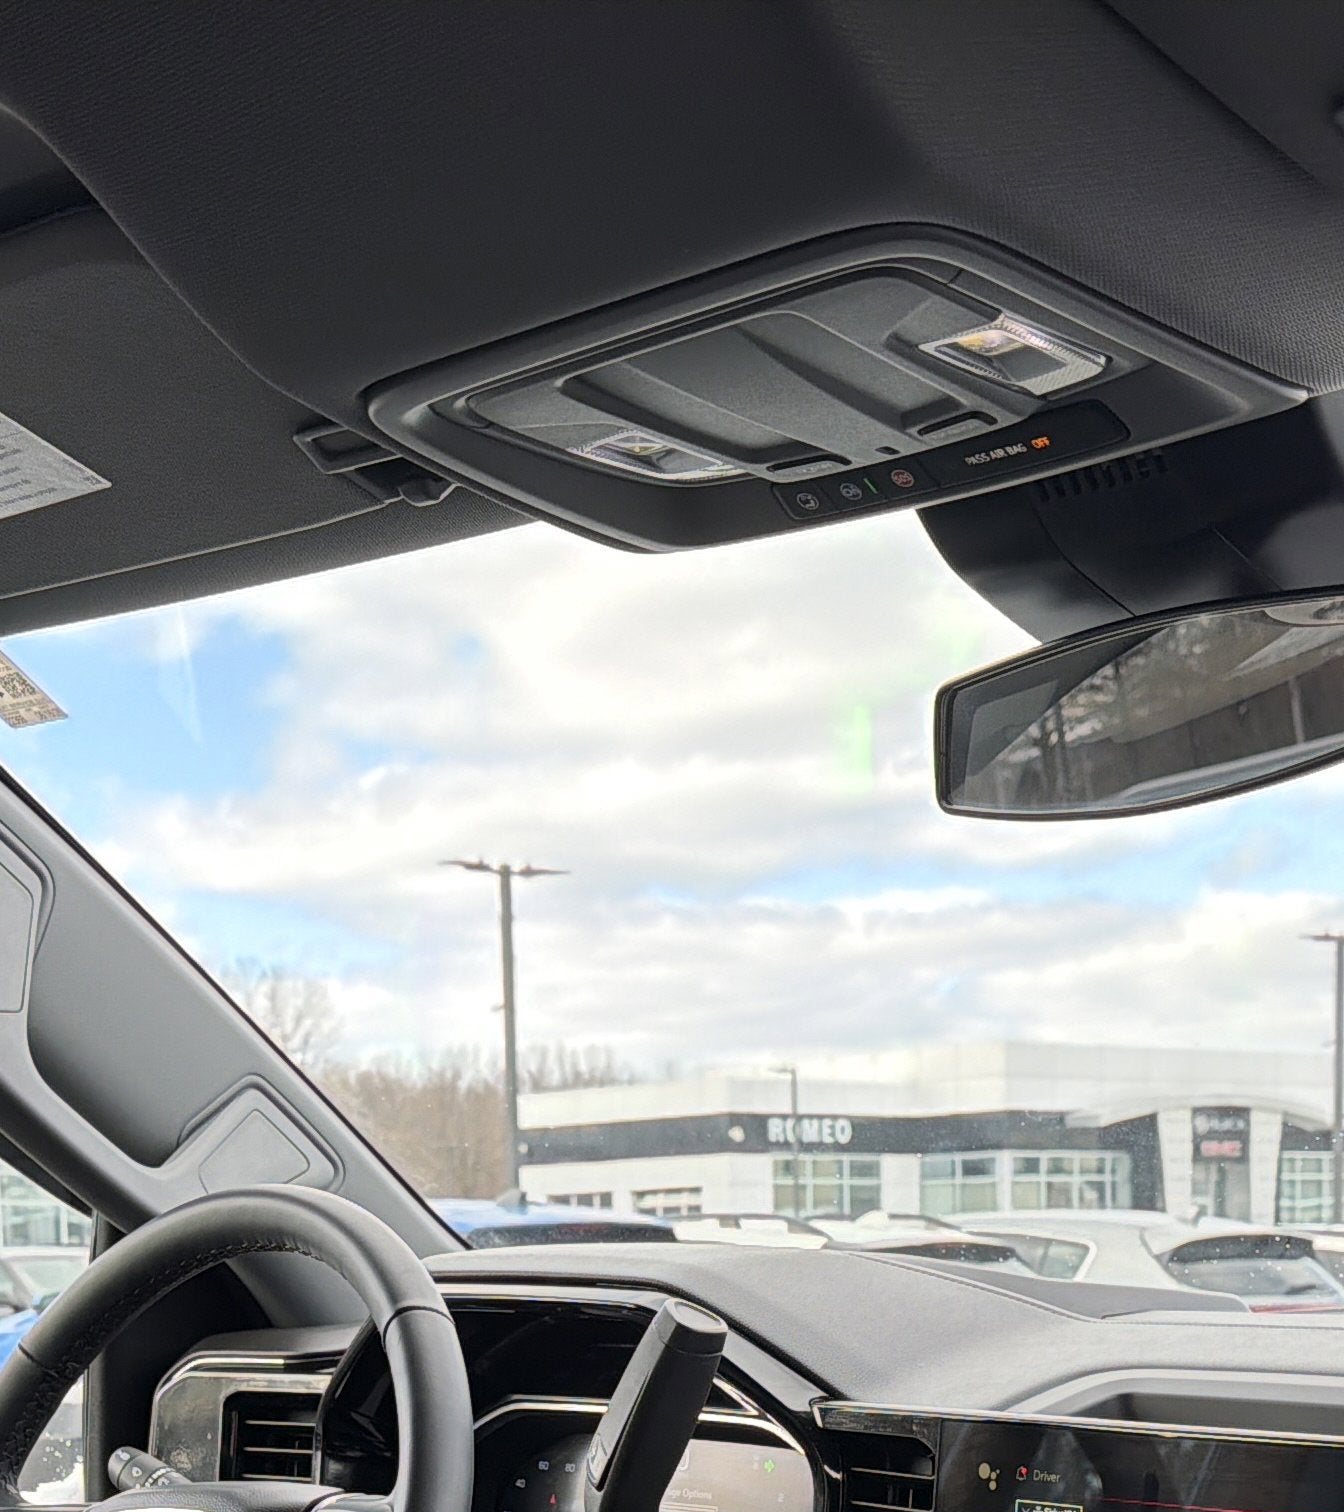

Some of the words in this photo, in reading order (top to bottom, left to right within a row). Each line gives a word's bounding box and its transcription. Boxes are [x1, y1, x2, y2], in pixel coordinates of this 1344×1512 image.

[964, 453, 990, 467] PASS
[990, 448, 1007, 461] AIR
[1007, 443, 1028, 457] BAG
[1030, 436, 1052, 449] OFF
[538, 1461, 549, 1470] 60
[564, 1463, 576, 1472] 80
[1033, 1470, 1060, 1483] Driver
